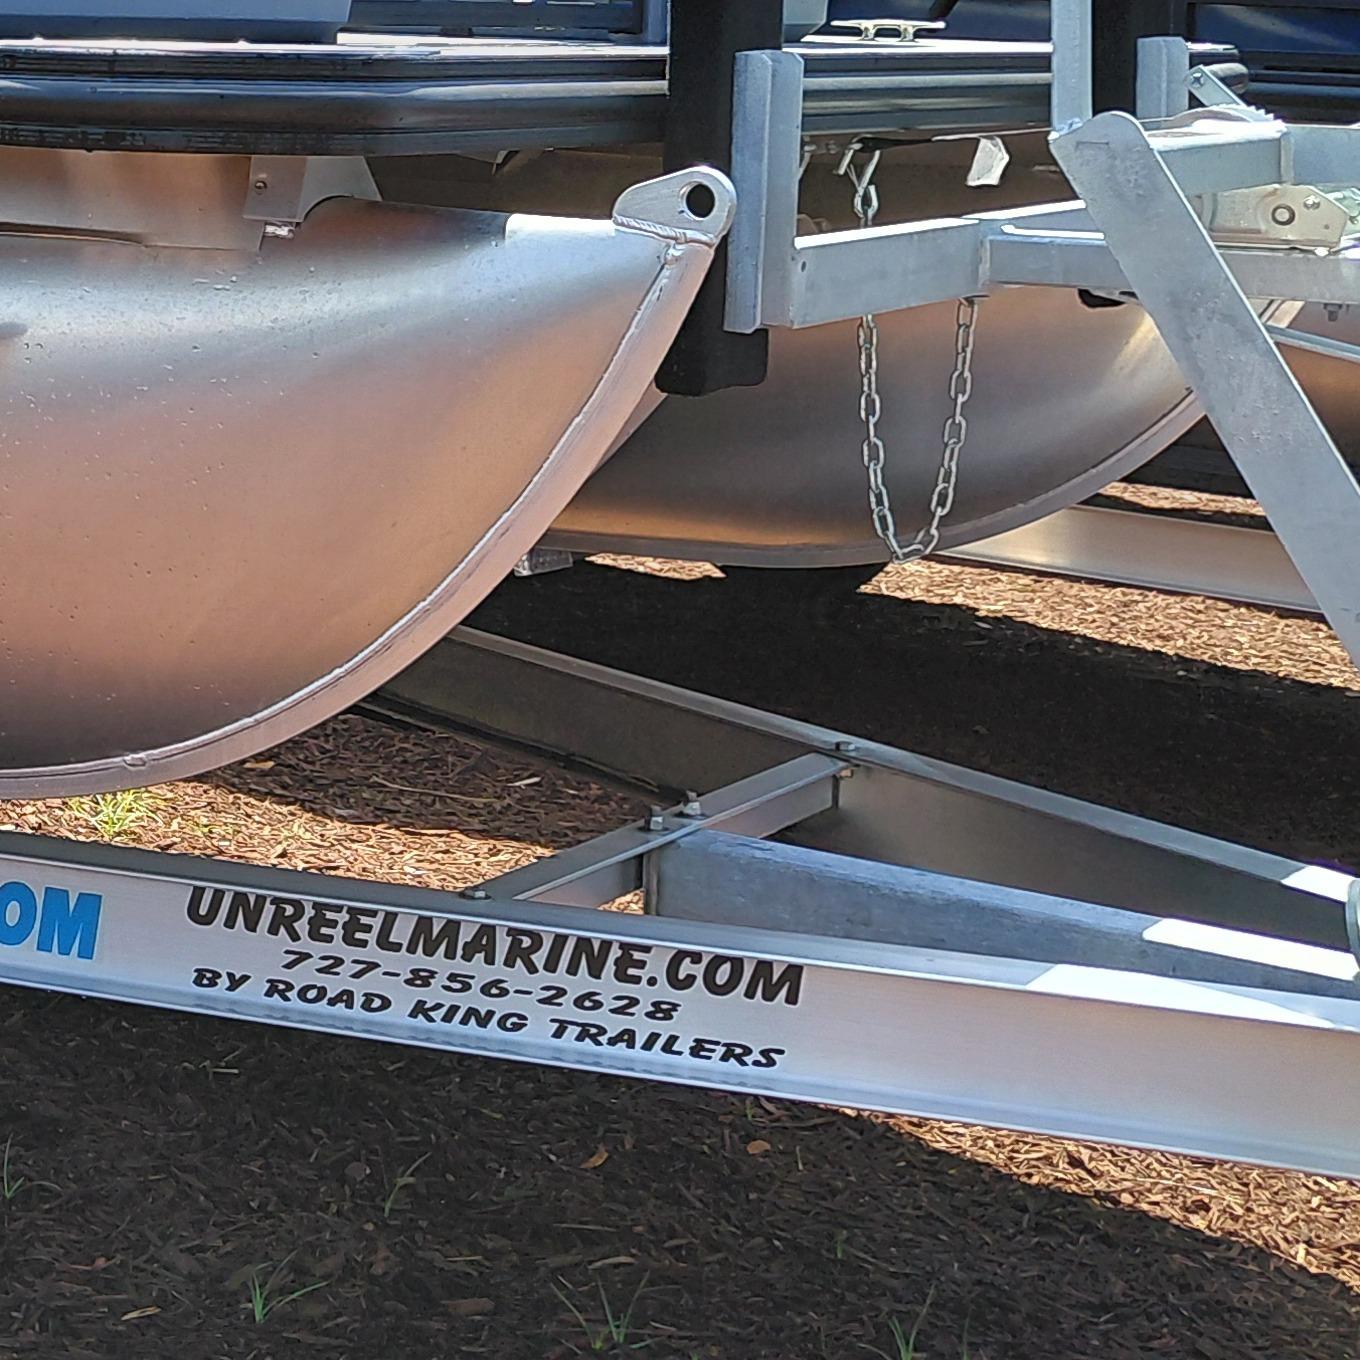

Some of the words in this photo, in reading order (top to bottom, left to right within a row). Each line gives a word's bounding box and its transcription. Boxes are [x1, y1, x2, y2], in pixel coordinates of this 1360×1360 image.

[186, 886, 805, 1006] UNREELMARINE.COM
[281, 949, 682, 1022] 727-856-2628
[192, 967, 251, 993] BY
[263, 978, 391, 1014] ROAD
[408, 999, 528, 1034] KING
[549, 1018, 786, 1070] TRAILERS
